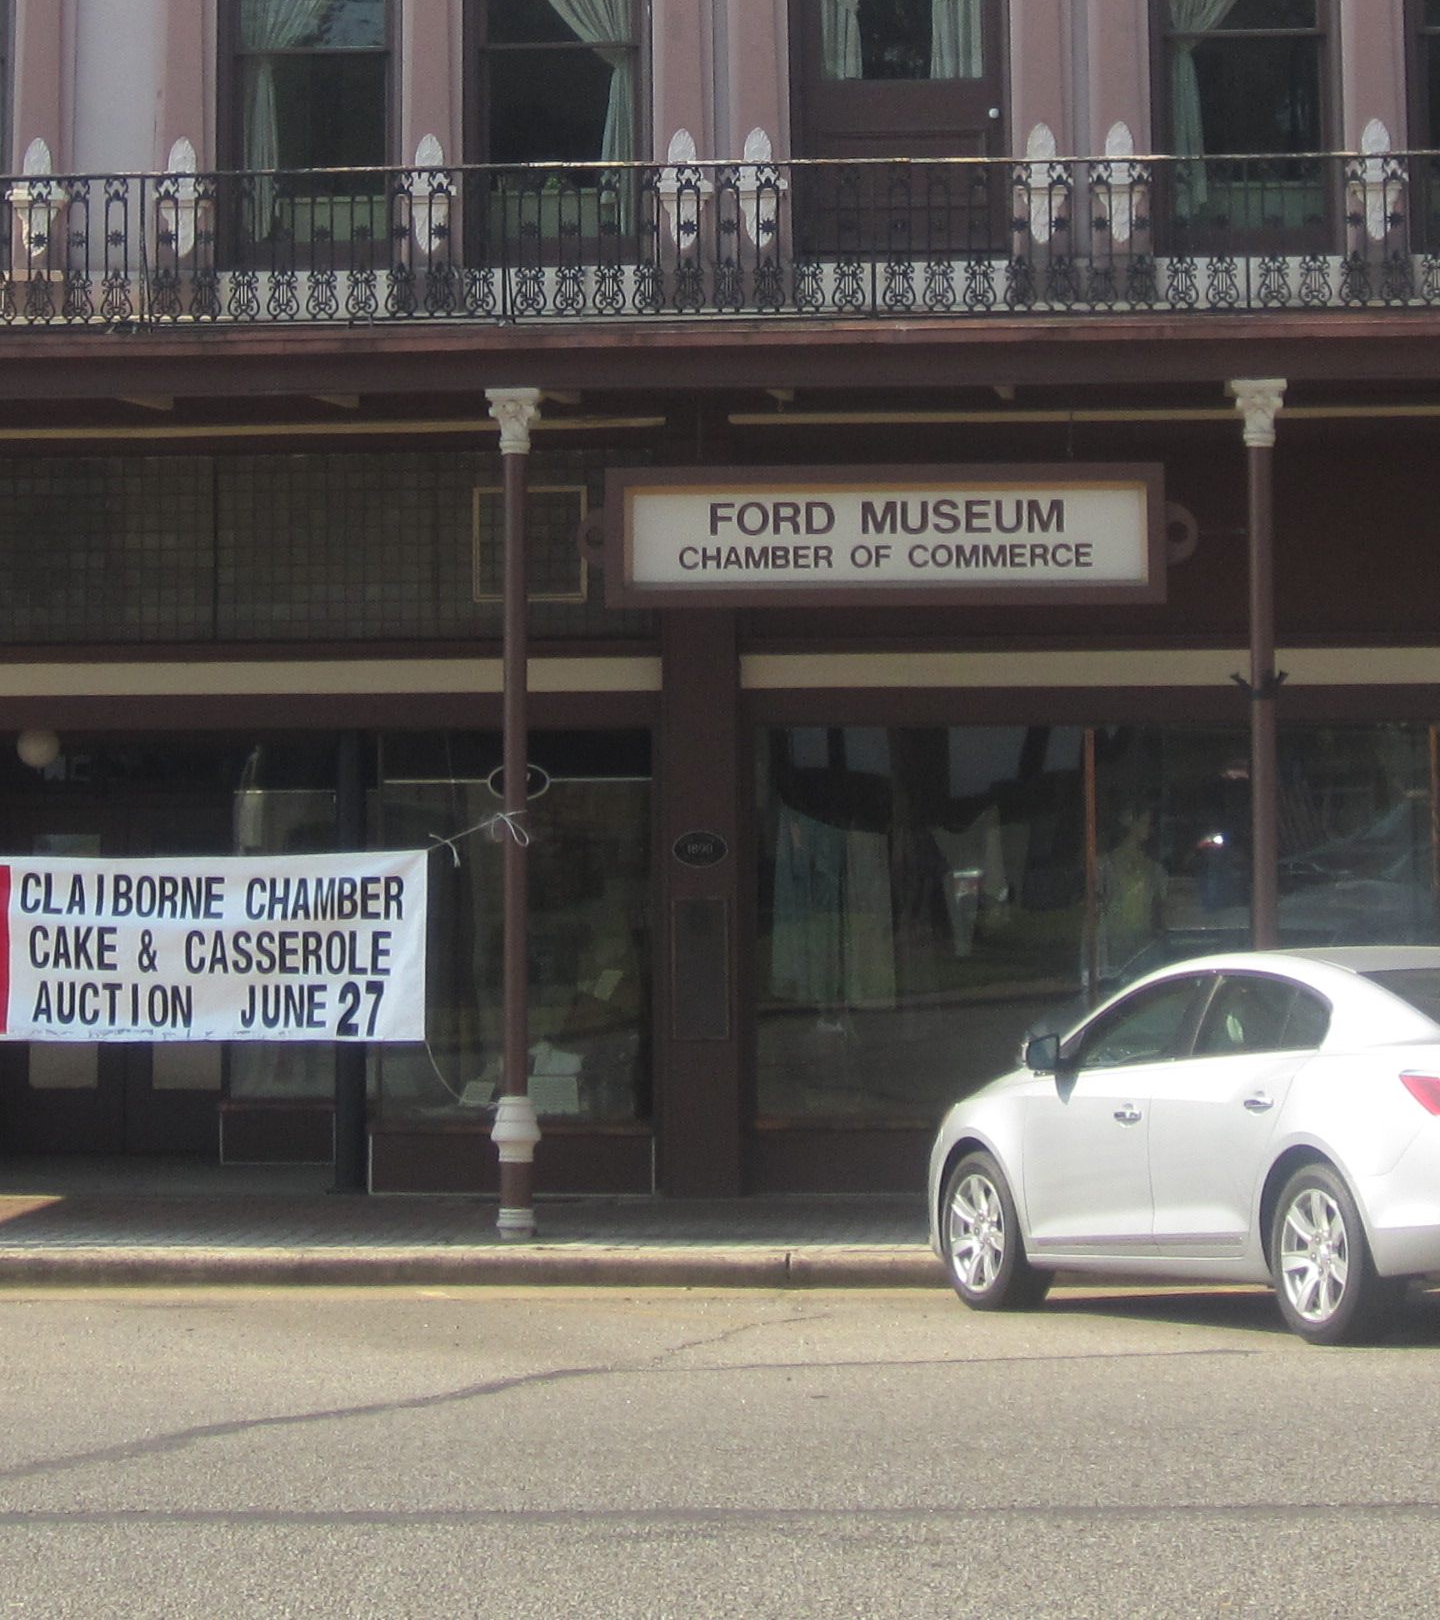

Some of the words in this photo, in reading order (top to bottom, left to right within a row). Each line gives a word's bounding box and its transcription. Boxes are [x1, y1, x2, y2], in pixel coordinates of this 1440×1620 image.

[710, 501, 836, 536] FORD
[861, 498, 1065, 534] MUSEUM
[678, 545, 834, 570] CHAMBER
[850, 544, 892, 568] OF
[908, 542, 1093, 568] COMMERCE
[20, 872, 225, 919] CLAIBORNE
[245, 876, 404, 921] CHAMBER
[29, 925, 118, 970] CAKE
[137, 929, 158, 973] &
[185, 930, 392, 975] CASSEROLE
[32, 980, 193, 1028] AUCTION
[240, 983, 328, 1029] JUNE
[335, 980, 385, 1038] 27
